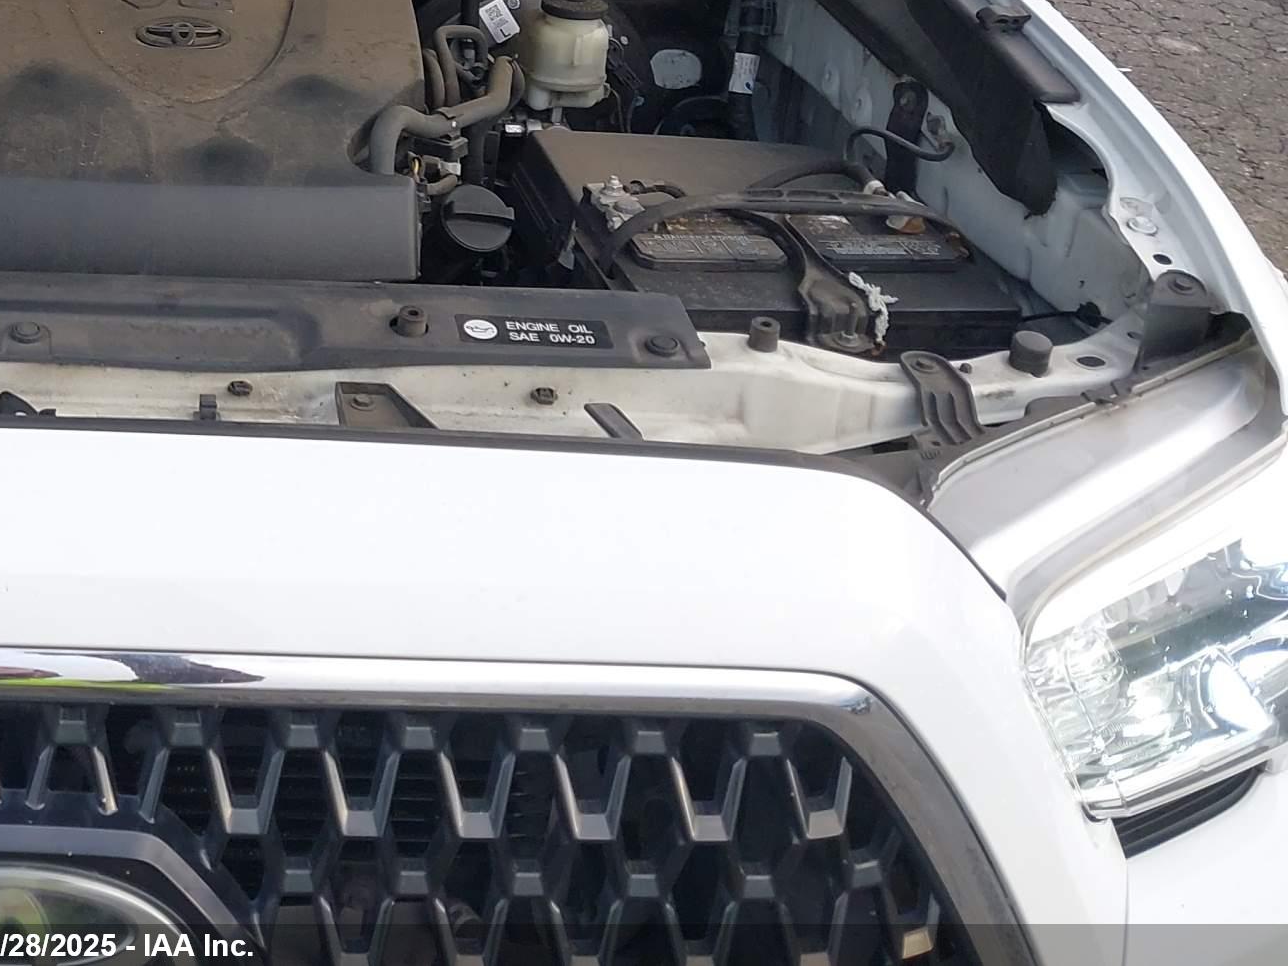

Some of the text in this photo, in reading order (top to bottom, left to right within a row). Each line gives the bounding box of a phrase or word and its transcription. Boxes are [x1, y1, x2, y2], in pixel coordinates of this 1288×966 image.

[506, 321, 593, 334] ENGINE OIL
[509, 332, 595, 344] SAE 0W-20
